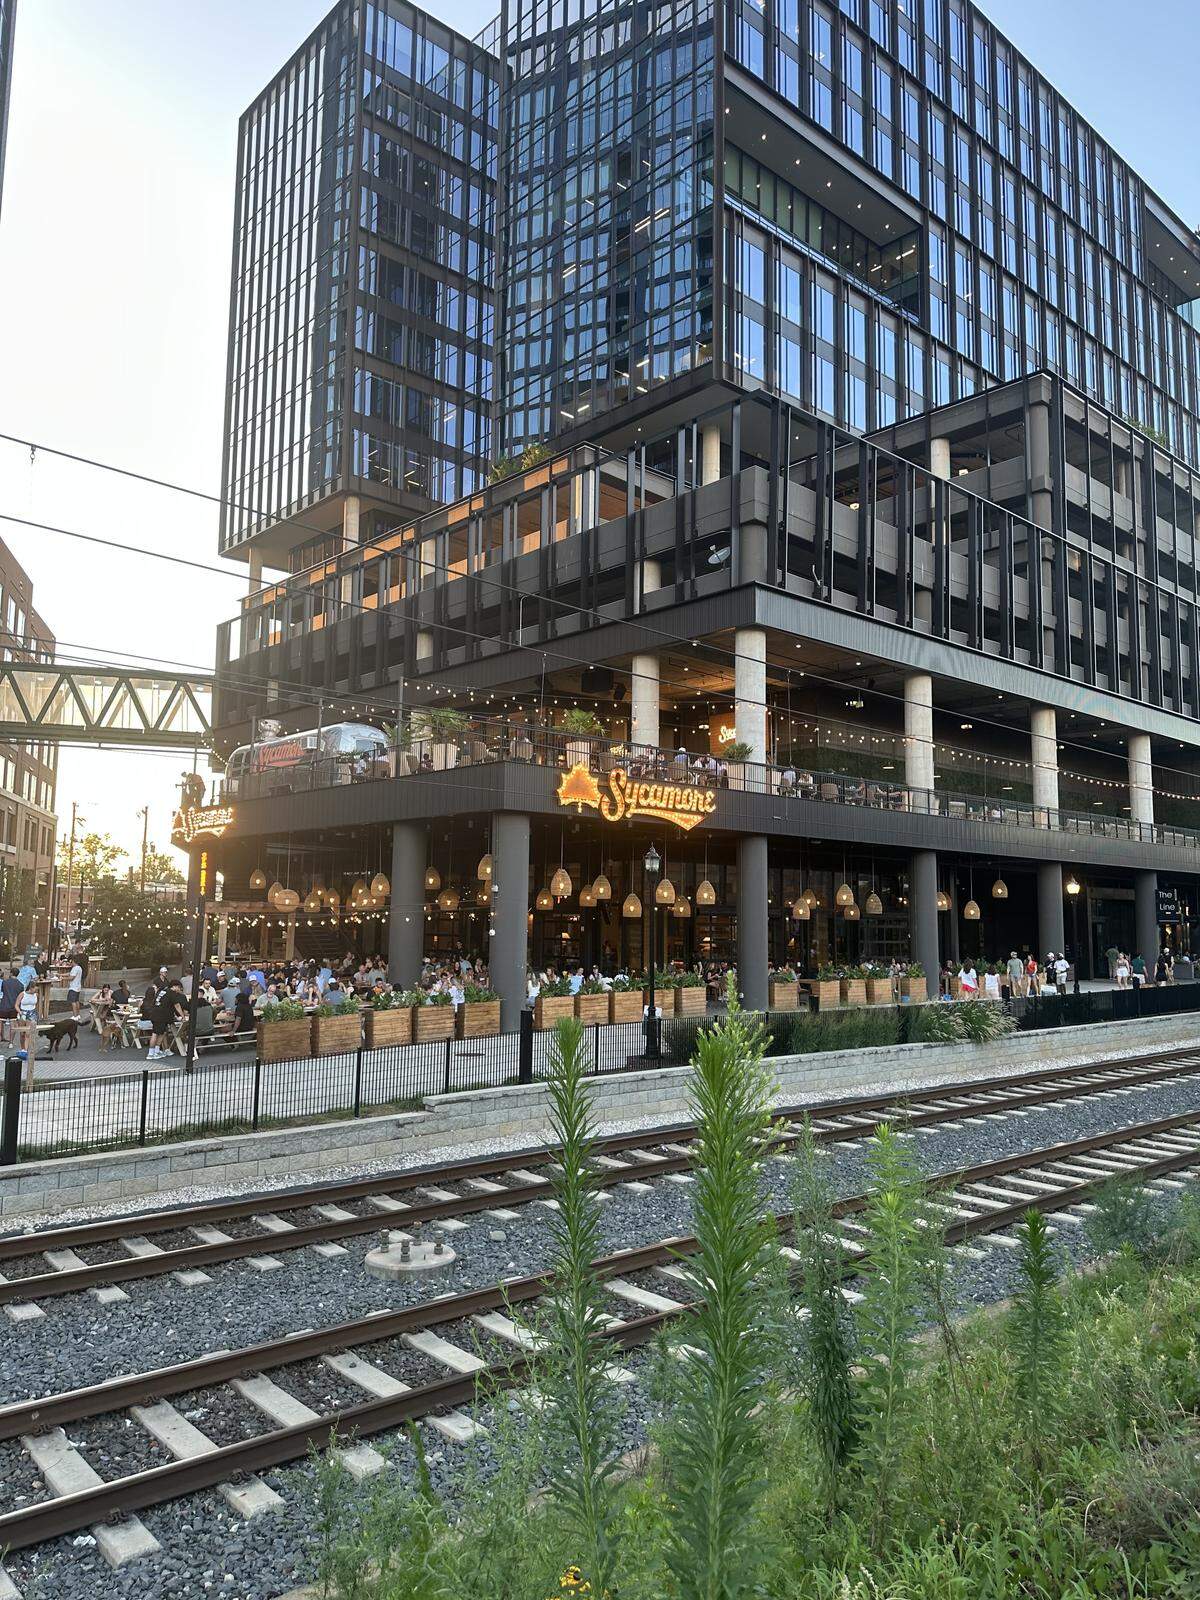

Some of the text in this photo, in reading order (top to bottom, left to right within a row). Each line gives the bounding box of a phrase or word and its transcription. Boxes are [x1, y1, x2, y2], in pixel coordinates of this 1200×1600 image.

[601, 767, 717, 822] Sycamore
[1158, 890, 1173, 899] The
[1159, 903, 1176, 911] Line
